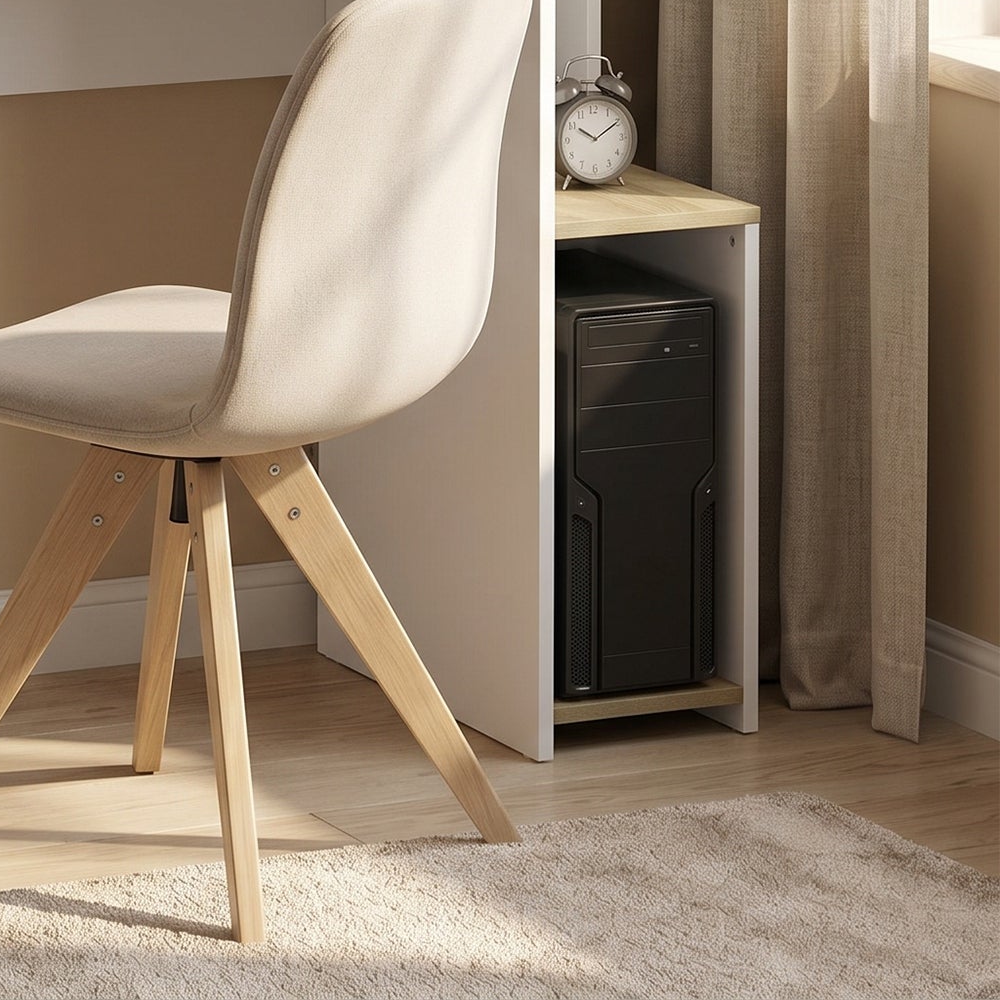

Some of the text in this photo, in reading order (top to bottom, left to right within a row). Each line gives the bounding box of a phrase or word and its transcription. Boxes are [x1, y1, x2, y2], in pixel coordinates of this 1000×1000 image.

[589, 105, 598, 114] 12
[577, 110, 584, 119] 11
[565, 137, 570, 145] 9
[619, 133, 624, 141] 3
[592, 164, 598, 173] 6
